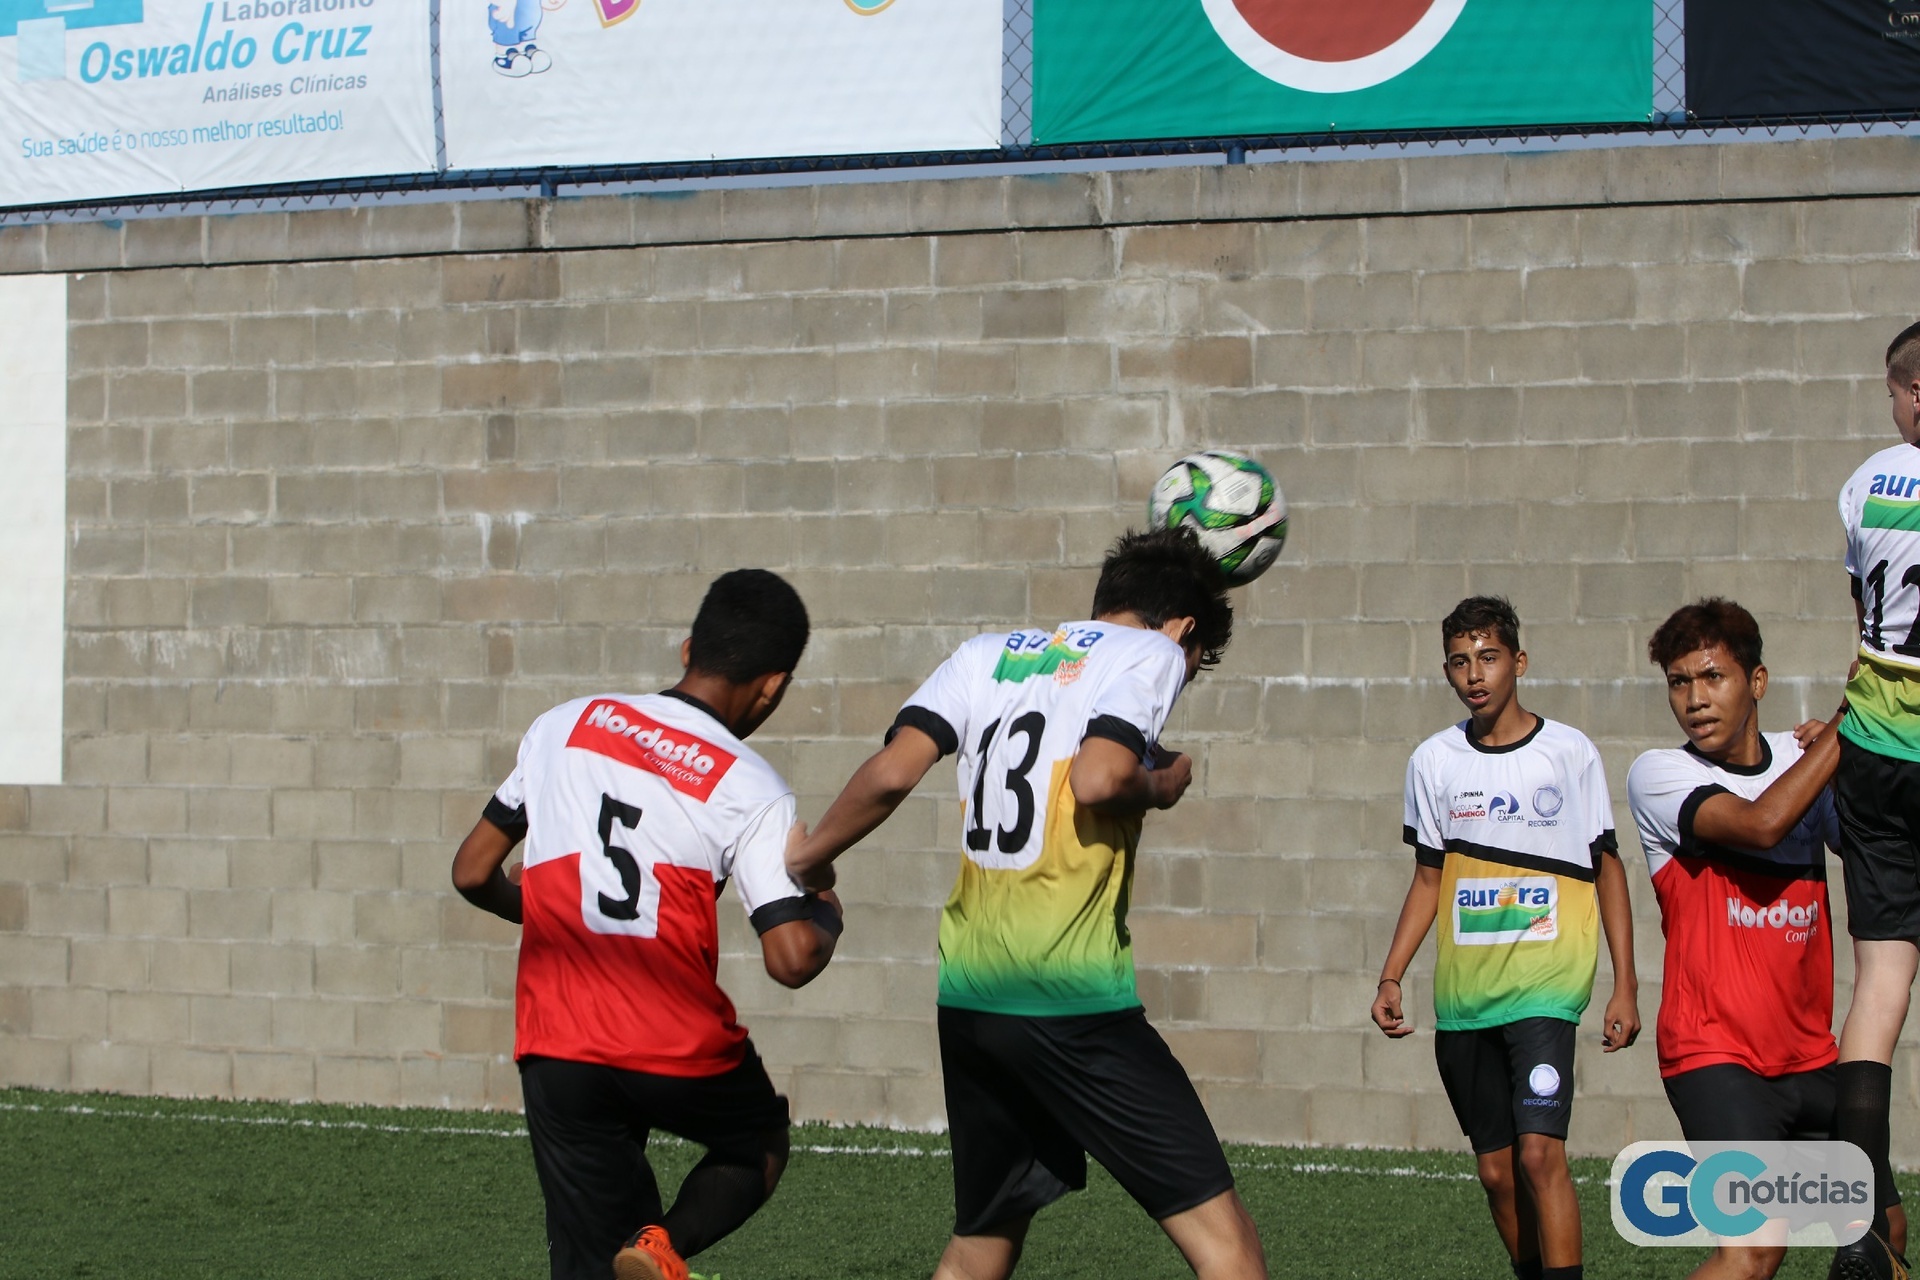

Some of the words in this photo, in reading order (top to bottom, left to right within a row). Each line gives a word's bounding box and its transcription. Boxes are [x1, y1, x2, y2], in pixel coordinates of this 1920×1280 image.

[80, 2, 257, 84] Oswaldo
[272, 22, 373, 65] Cruz
[202, 81, 283, 104] Análises
[290, 73, 368, 95] Clínicas
[22, 138, 54, 158] Sua
[58, 132, 109, 155] saúde
[112, 129, 122, 151] é
[126, 133, 137, 149] o
[141, 129, 188, 148] nosso
[193, 120, 253, 144] melhor
[257, 110, 344, 137] resultado!
[1869, 473, 1920, 498] aur
[966, 711, 1046, 854] 13
[597, 792, 643, 921] 5
[1458, 887, 1549, 907] aurora
